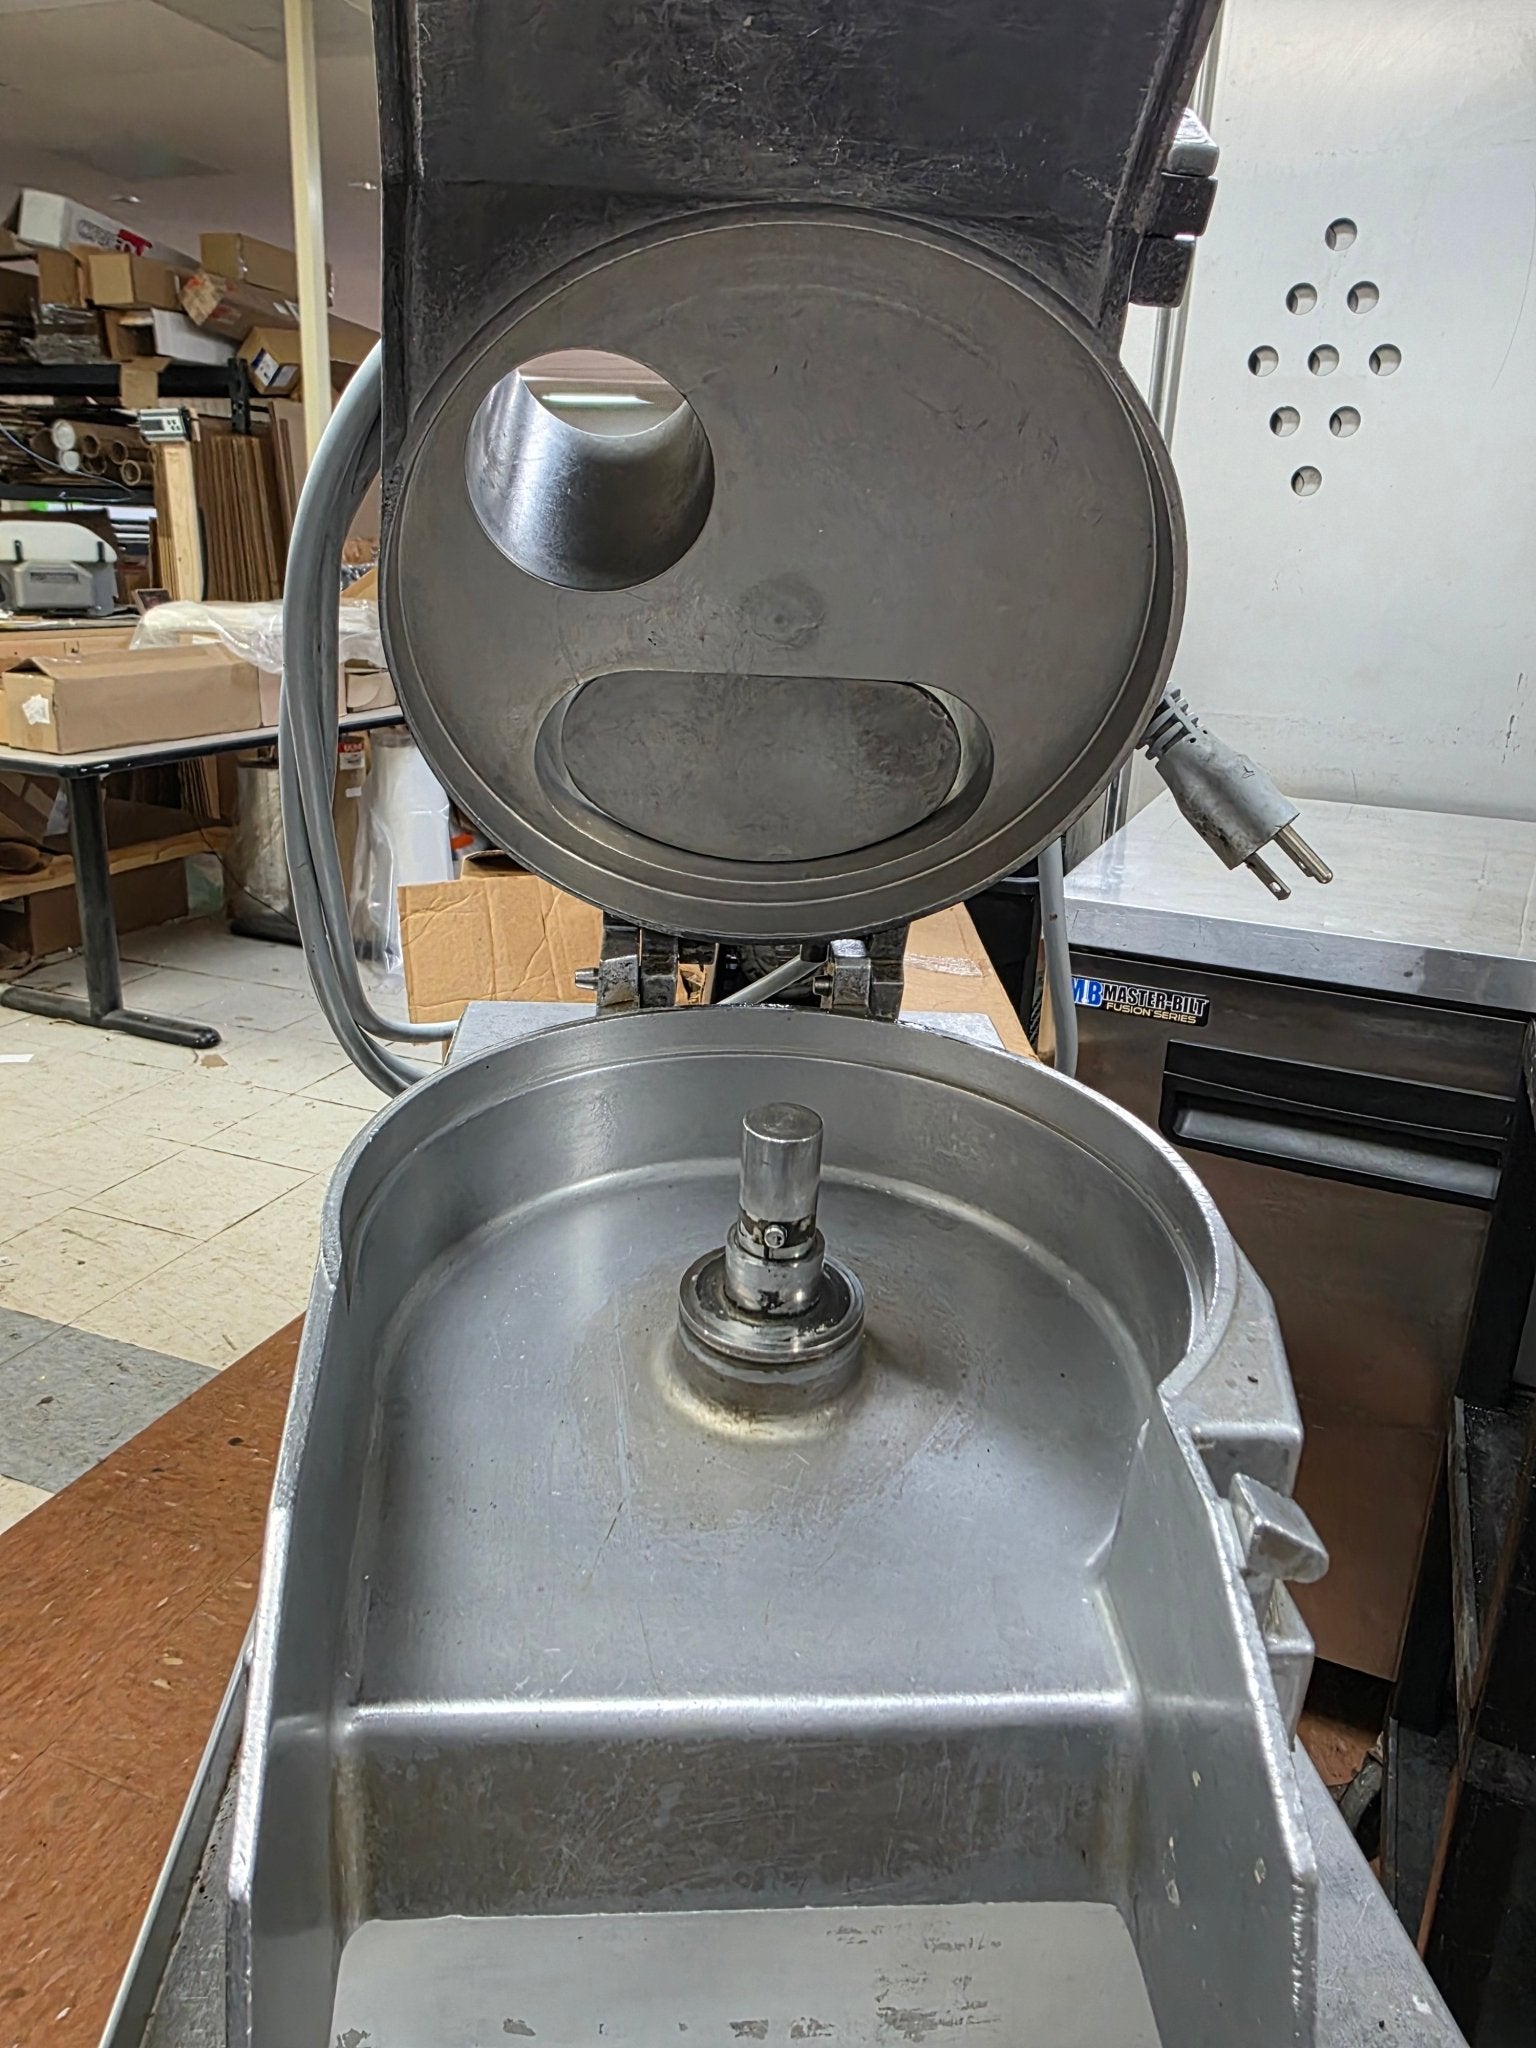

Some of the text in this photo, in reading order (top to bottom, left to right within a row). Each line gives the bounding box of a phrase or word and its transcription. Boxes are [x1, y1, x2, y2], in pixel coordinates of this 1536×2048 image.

[1103, 984, 1207, 1017] MASTER-BILT
[1106, 1002, 1197, 1024] FUSION SERIES
